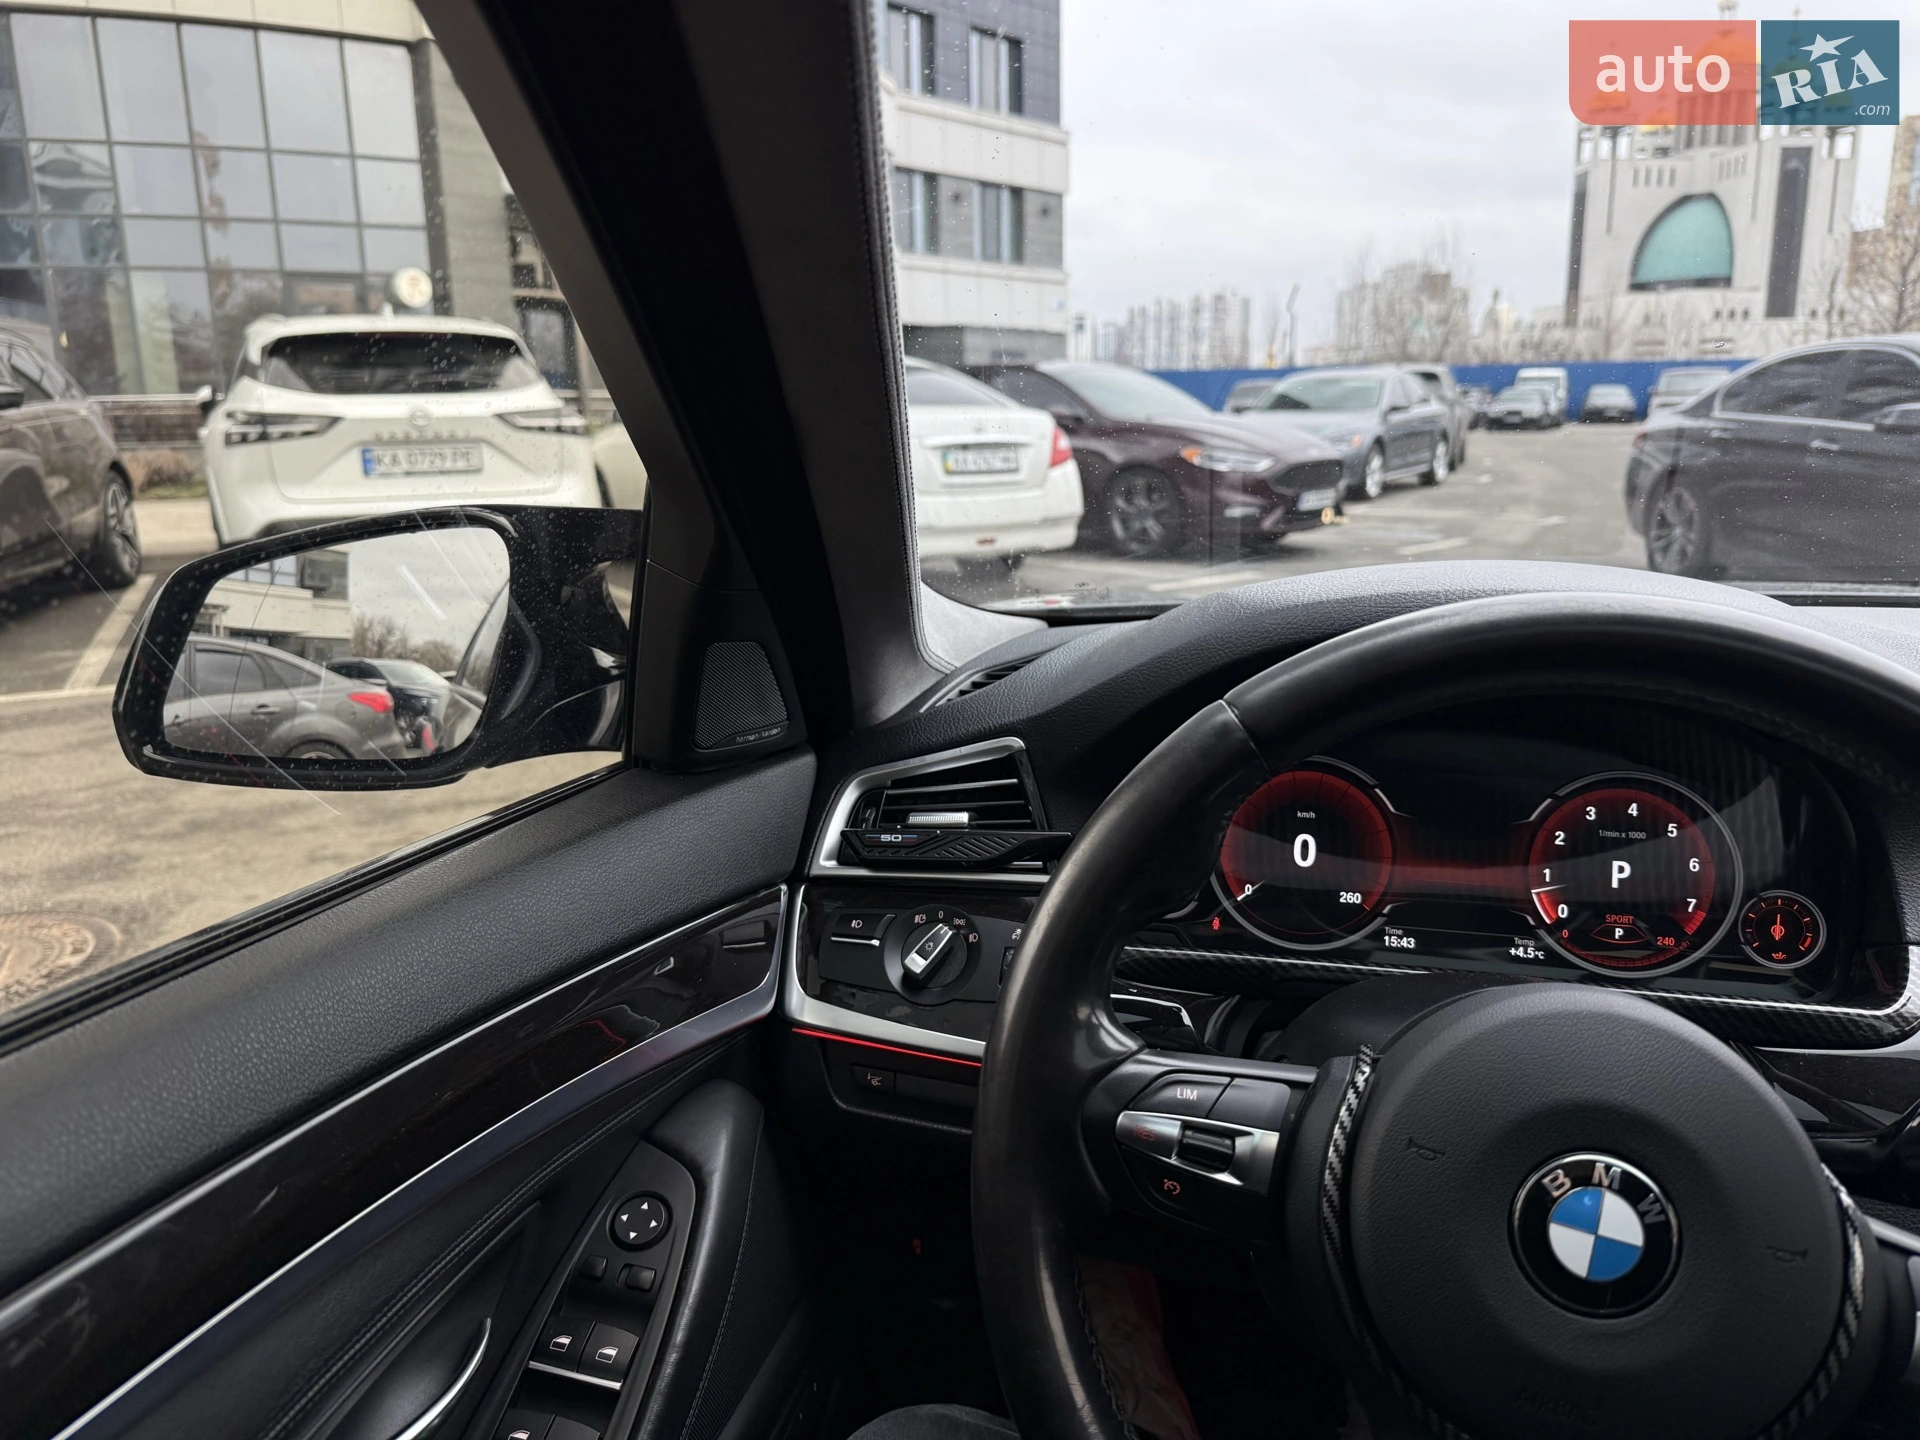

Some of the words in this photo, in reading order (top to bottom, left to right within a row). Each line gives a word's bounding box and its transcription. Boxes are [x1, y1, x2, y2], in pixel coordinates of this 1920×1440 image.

[1297, 810, 1316, 819] km/h
[1585, 806, 1596, 820] 3
[1627, 803, 1638, 816] 4
[1627, 831, 1647, 840] 1000
[1667, 823, 1678, 838] 5
[880, 834, 902, 842] 50
[1554, 832, 1565, 845] 2
[1293, 833, 1316, 868] 0
[1688, 857, 1700, 872] 6
[1543, 868, 1551, 882] 1
[1610, 860, 1631, 889] P
[1245, 884, 1252, 895] 0
[1339, 891, 1361, 904] 260
[1557, 904, 1568, 918] 0
[1686, 898, 1697, 912] 7
[1605, 914, 1634, 924] SPORT
[1384, 926, 1403, 935] Time
[1562, 929, 1568, 937] 0
[1615, 928, 1624, 939] P
[1383, 935, 1415, 949] 15:43
[1514, 937, 1535, 947] Temp
[1656, 936, 1675, 946] 240
[1176, 1088, 1198, 1100] LIM
[1541, 1162, 1666, 1224] BMW
